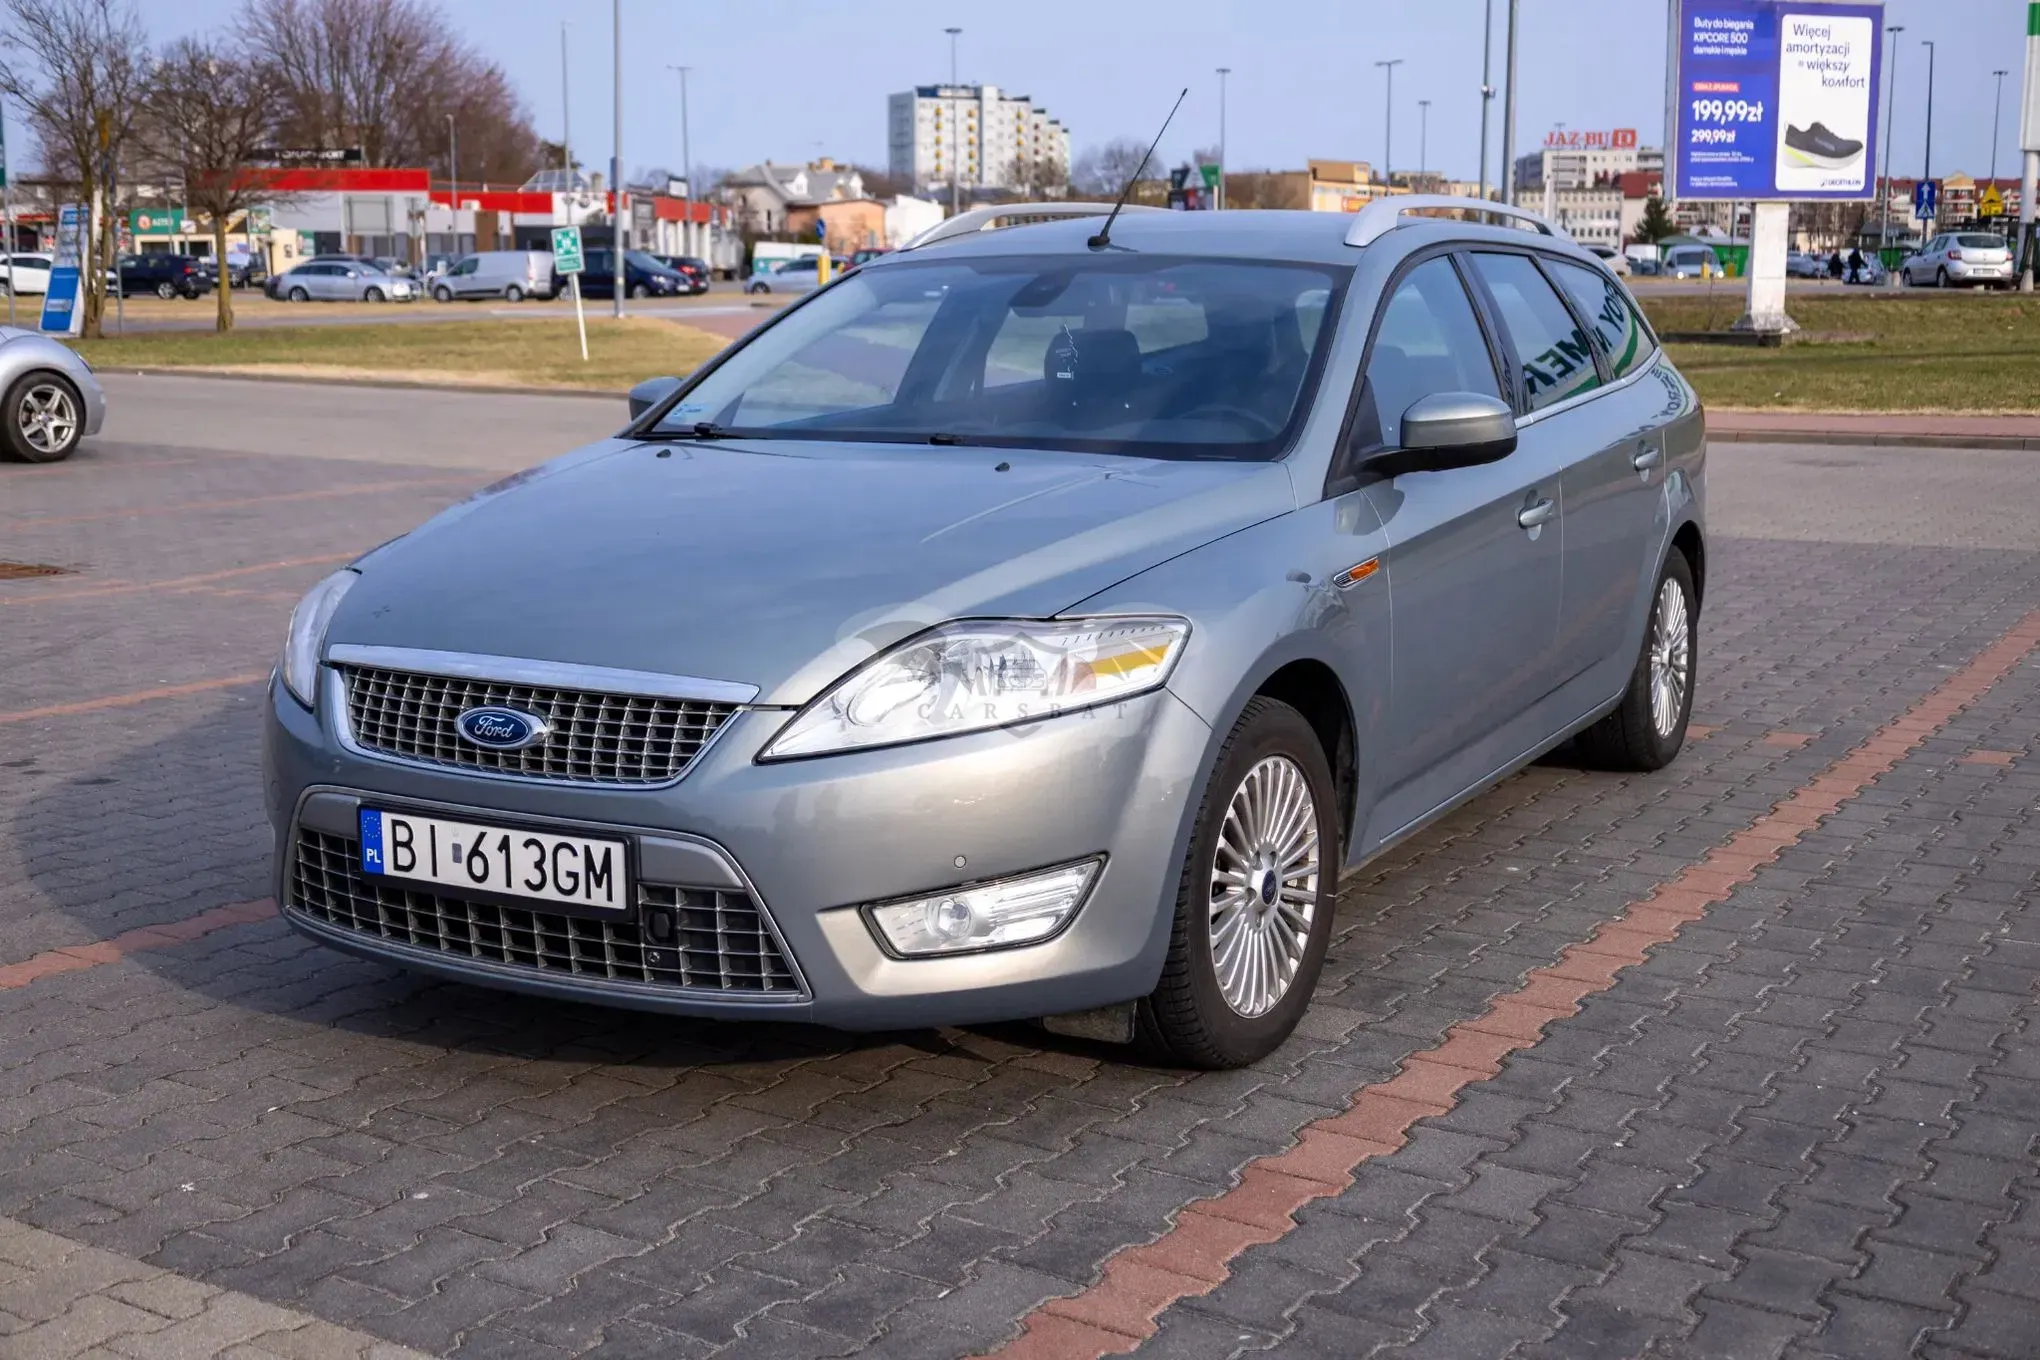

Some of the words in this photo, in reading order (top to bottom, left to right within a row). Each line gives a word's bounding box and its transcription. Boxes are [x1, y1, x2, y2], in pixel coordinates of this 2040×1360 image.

[1694, 16, 1712, 30] Buty
[1713, 18, 1723, 29] do
[1723, 18, 1754, 31] biegania
[1793, 23, 1831, 41] Więcej
[1730, 32, 1748, 44] 500
[1786, 41, 1850, 58] amortyzacji
[1806, 57, 1850, 74] większy
[1821, 74, 1865, 88] komfort
[474, 715, 515, 738] Ford
[366, 848, 382, 864] PL
[391, 819, 438, 878] BI
[466, 831, 614, 902] 613GM
